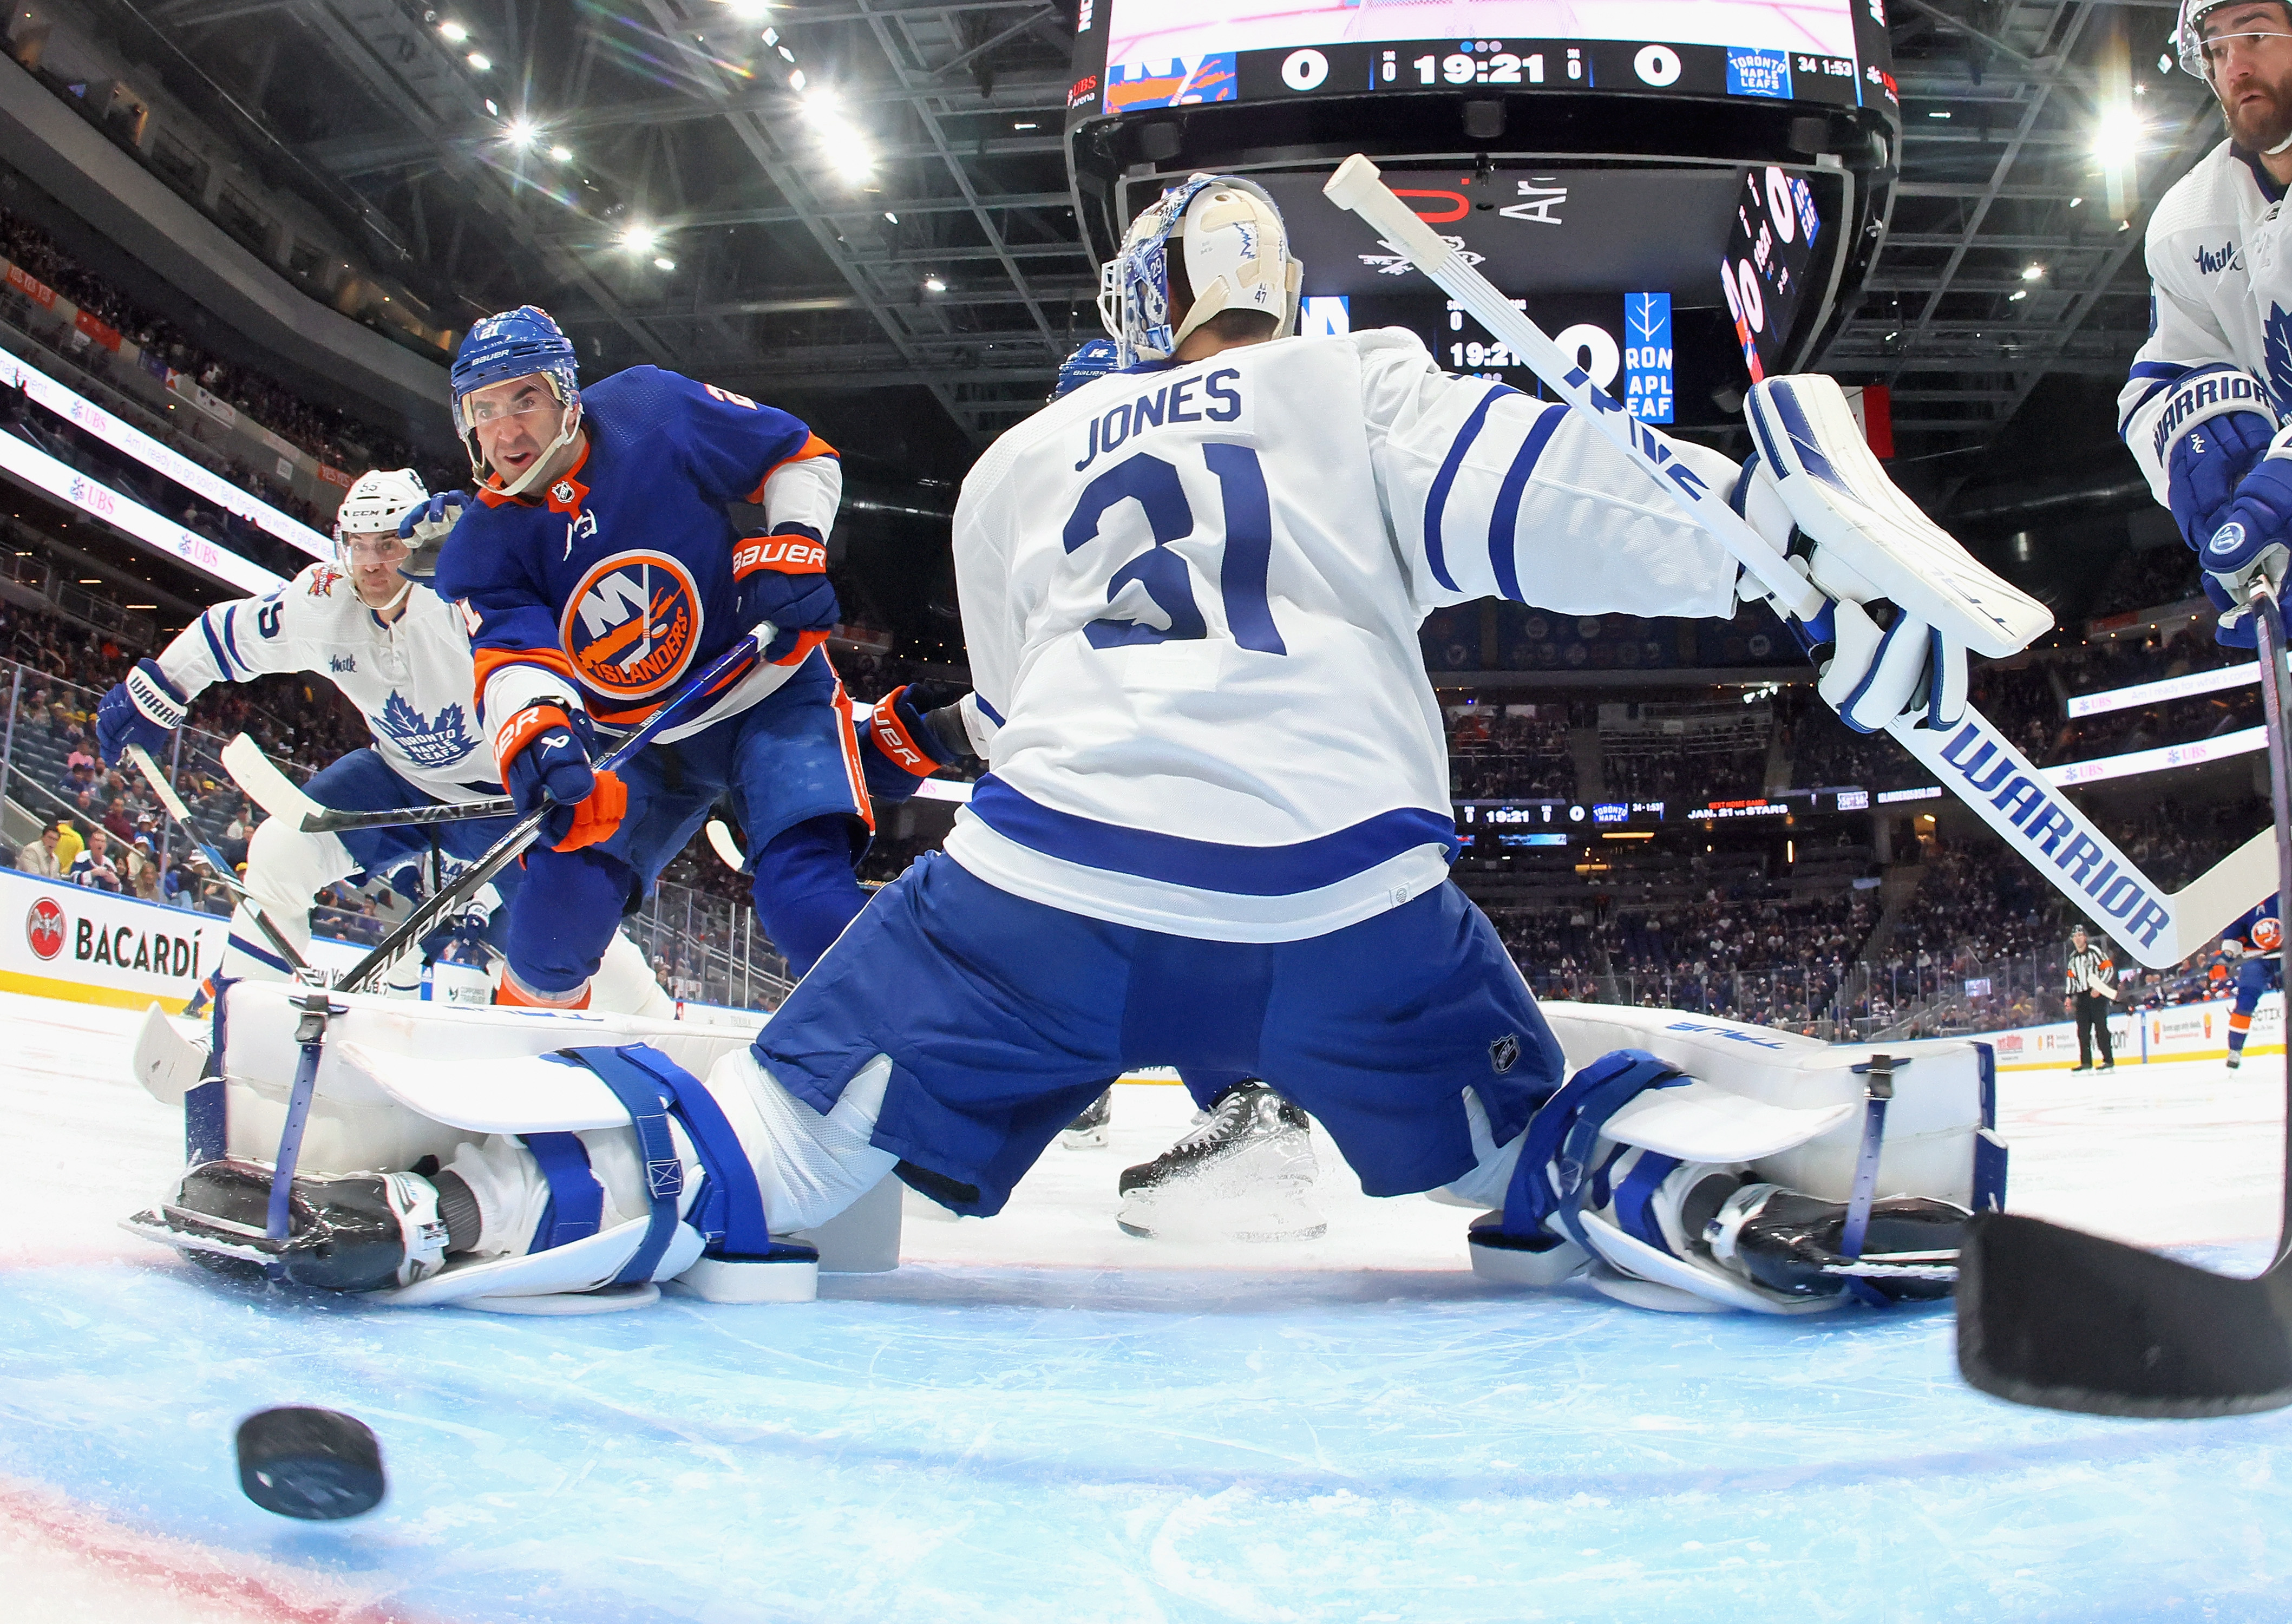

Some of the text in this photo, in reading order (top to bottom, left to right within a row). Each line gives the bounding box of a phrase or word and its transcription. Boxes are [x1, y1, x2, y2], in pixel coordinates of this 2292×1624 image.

[1281, 49, 1328, 90] 0
[1383, 62, 1396, 82] 0
[1413, 53, 1544, 84] 19:21
[1568, 59, 1581, 80] 0
[1633, 44, 1681, 87] 0
[1730, 55, 1786, 74] TORONTO
[1740, 67, 1778, 80] MAPLE
[1797, 56, 1853, 77] 34 1:53
[1073, 75, 1097, 96] UBS
[1741, 77, 1779, 90] LEAFS
[1072, 91, 1095, 108] Arena
[1151, 257, 1162, 279] 29
[1254, 291, 1267, 304] 47
[1450, 311, 1462, 331] 0
[472, 349, 510, 366] BAUER
[1075, 368, 1241, 472] JONES
[83, 407, 107, 432] UBS
[148, 447, 171, 470] ready
[88, 485, 219, 567] UBS UBS
[732, 543, 826, 574] BAUER
[1063, 442, 1287, 656] 31
[578, 564, 650, 675] NY
[594, 606, 687, 684] ISLANDERS
[2091, 696, 2111, 710] UBS
[2154, 683, 2179, 698] ready
[394, 729, 456, 746] TORONTO
[408, 739, 453, 754] MAPLE
[416, 745, 461, 760] LEAFS
[2079, 745, 2206, 778] UBS UBS
[921, 781, 937, 794] BS
[1486, 810, 1529, 823] 19:21
[1570, 806, 1585, 821] 0
[1593, 806, 1628, 817] TORONTO
[1687, 809, 1717, 819] JAN.
[1718, 808, 1733, 817] 21
[1746, 804, 1788, 816] STARS
[1940, 722, 2170, 949] WARRIOR
[76, 917, 203, 979] BACARDÍ
